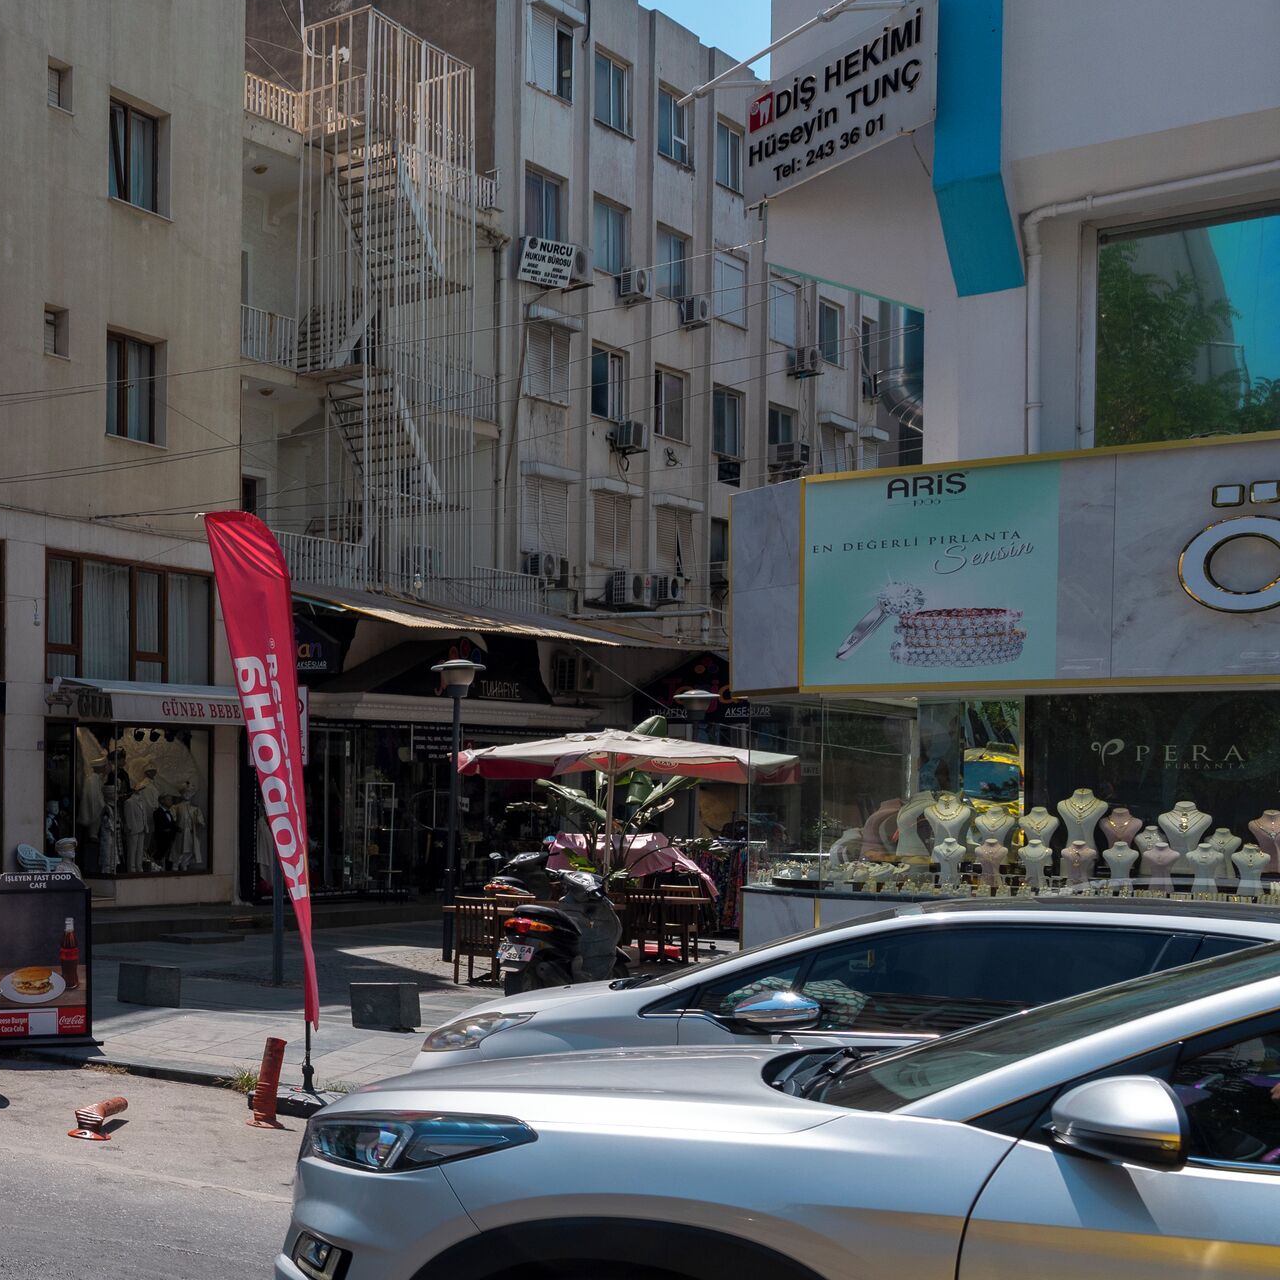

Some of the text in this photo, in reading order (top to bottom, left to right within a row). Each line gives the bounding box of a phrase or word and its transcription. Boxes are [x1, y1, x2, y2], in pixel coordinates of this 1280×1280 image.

[775, 7, 924, 120] DİŞ HEKİMİ
[748, 58, 922, 168] Hüseyin TUNÇ
[773, 113, 885, 182] Tel: 243 36 01
[539, 241, 573, 257] NURCU
[525, 251, 572, 268] HUKUK BÜROSU
[812, 529, 1022, 554] EN DEĞERLİ PIRLANTA
[932, 540, 1035, 575] Sensin
[161, 698, 241, 719] GÜNER BEBE
[1135, 744, 1246, 762] PERA
[5, 874, 33, 884] İŞLEYEN
[51, 873, 72, 881] FOOD
[1, 1025, 24, 1033] Coca-Cola
[58, 1014, 86, 1025] Coca-Cola
